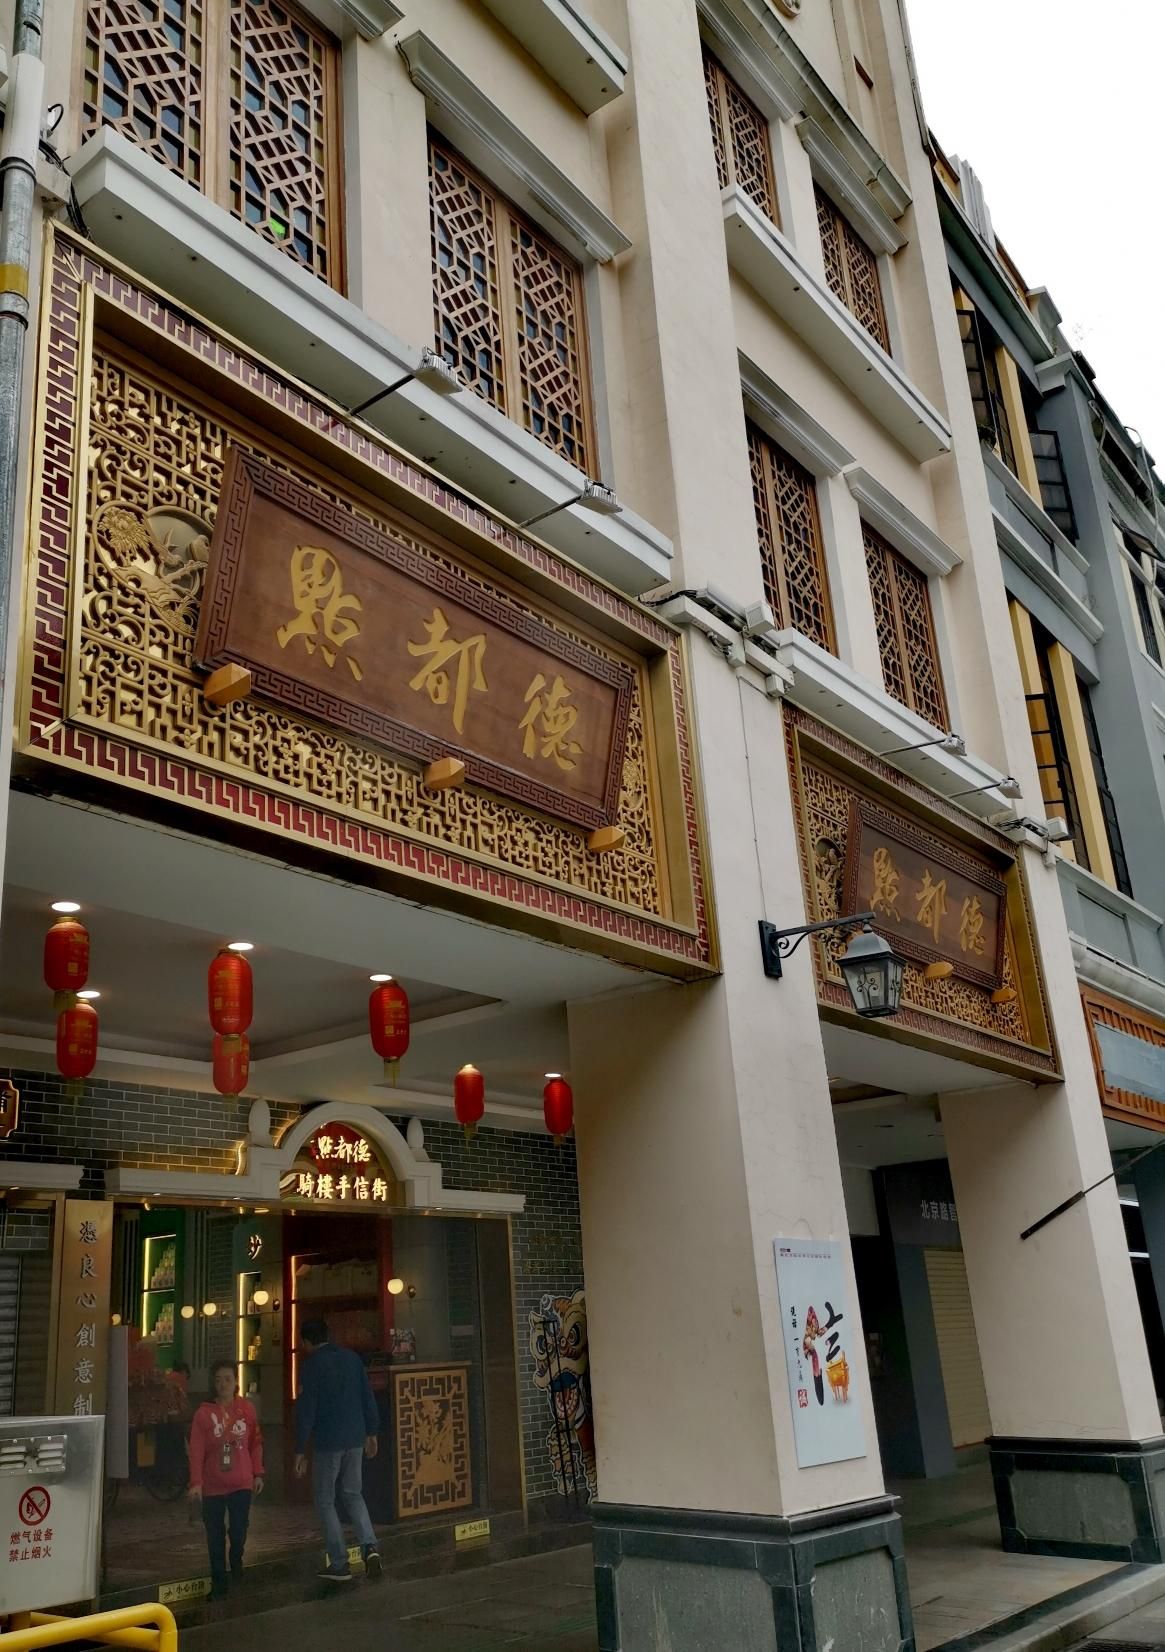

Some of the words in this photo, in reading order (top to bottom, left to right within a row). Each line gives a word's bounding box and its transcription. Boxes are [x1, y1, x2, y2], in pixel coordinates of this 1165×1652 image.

[276, 545, 583, 771] 點都德
[870, 847, 986, 956] 點都德
[315, 1136, 372, 1163] 點都德
[297, 1172, 388, 1201] 騎樓手信街
[10, 1528, 54, 1545] 燃气设备
[9, 1545, 52, 1562] 禁止烟火
